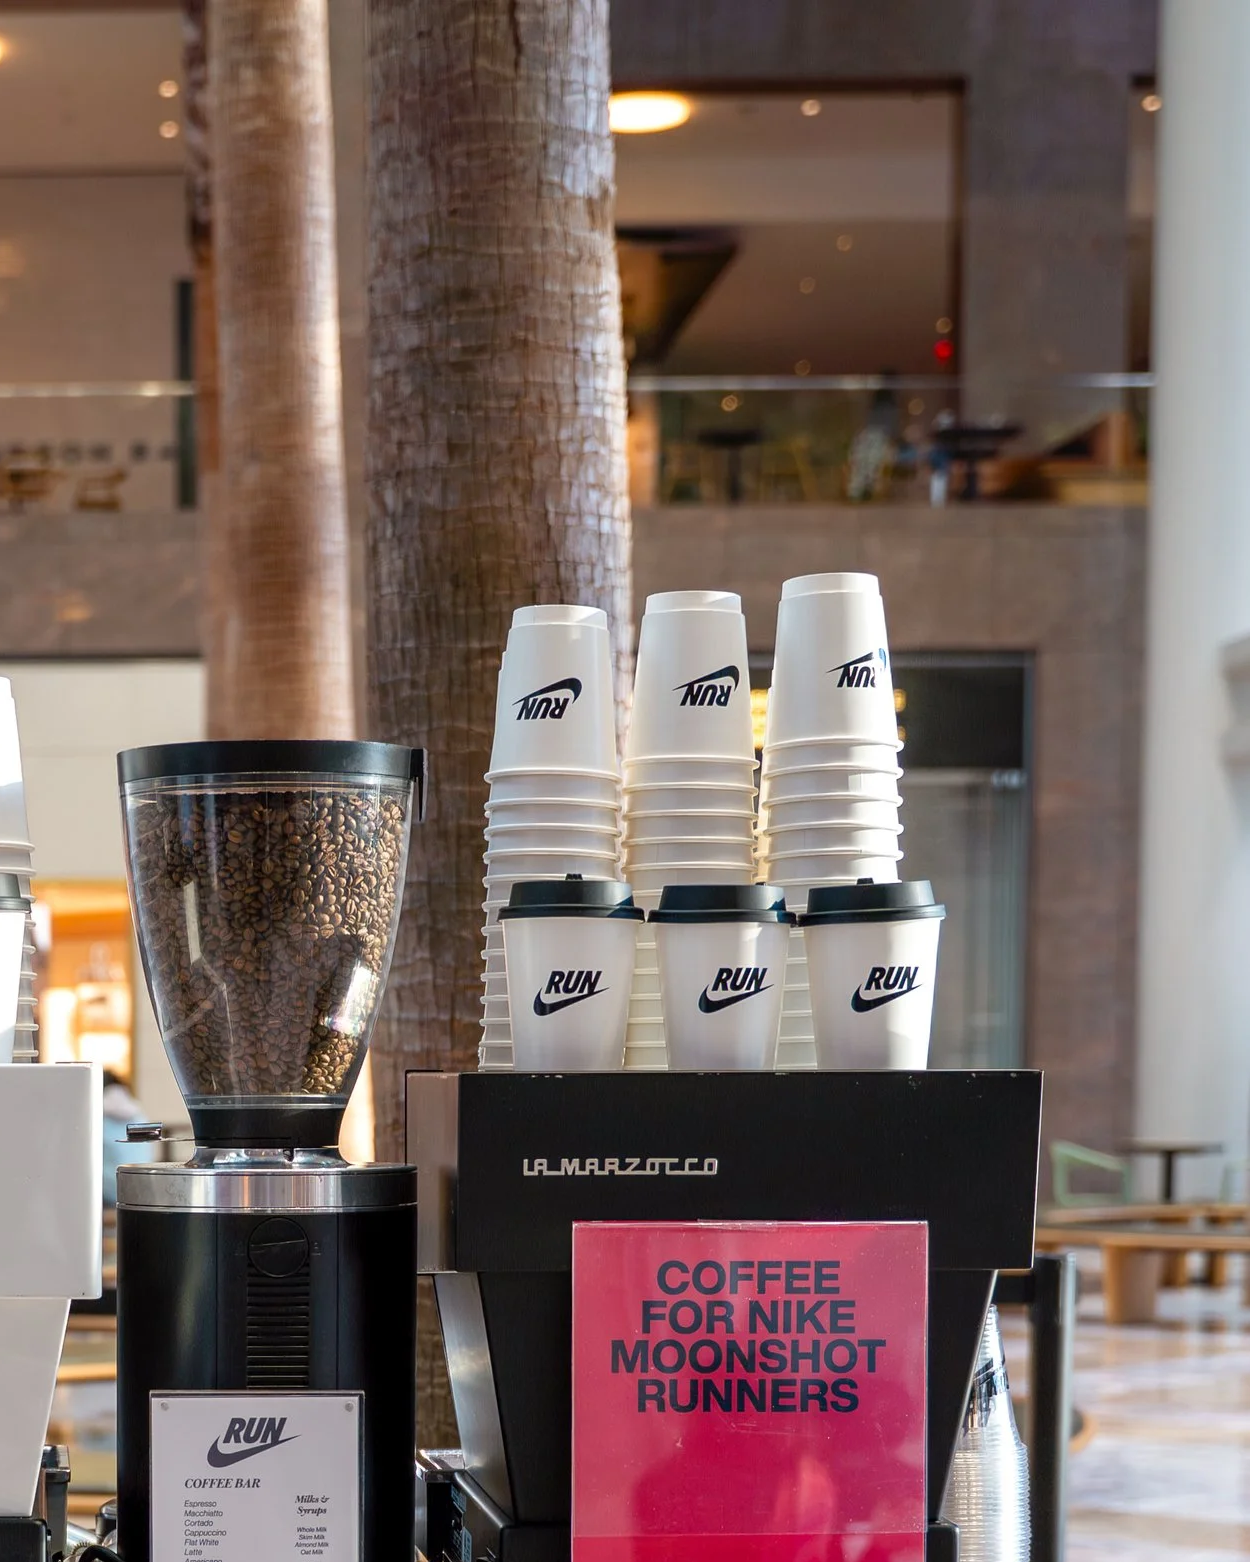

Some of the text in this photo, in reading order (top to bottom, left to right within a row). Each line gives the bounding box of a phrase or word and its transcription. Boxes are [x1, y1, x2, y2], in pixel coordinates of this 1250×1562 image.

[680, 684, 732, 707] RUN
[516, 697, 569, 720] RUN
[545, 971, 603, 994] RUN
[712, 968, 768, 991] RUN
[864, 967, 919, 990] RUN
[523, 1158, 547, 1176] LA
[656, 1260, 841, 1295] COFFEE
[642, 1300, 856, 1334] FOR NIKE
[611, 1339, 886, 1373] MOONSHOT
[637, 1378, 859, 1413] RUNNERS
[222, 1417, 287, 1444] RUN
[184, 1478, 261, 1489] COFFEE BAR
[184, 1500, 217, 1509] Espresso
[295, 1495, 319, 1503] Milks
[184, 1519, 213, 1527] Cortado
[296, 1506, 327, 1517] Syrups
[184, 1529, 226, 1538] Cappuccino
